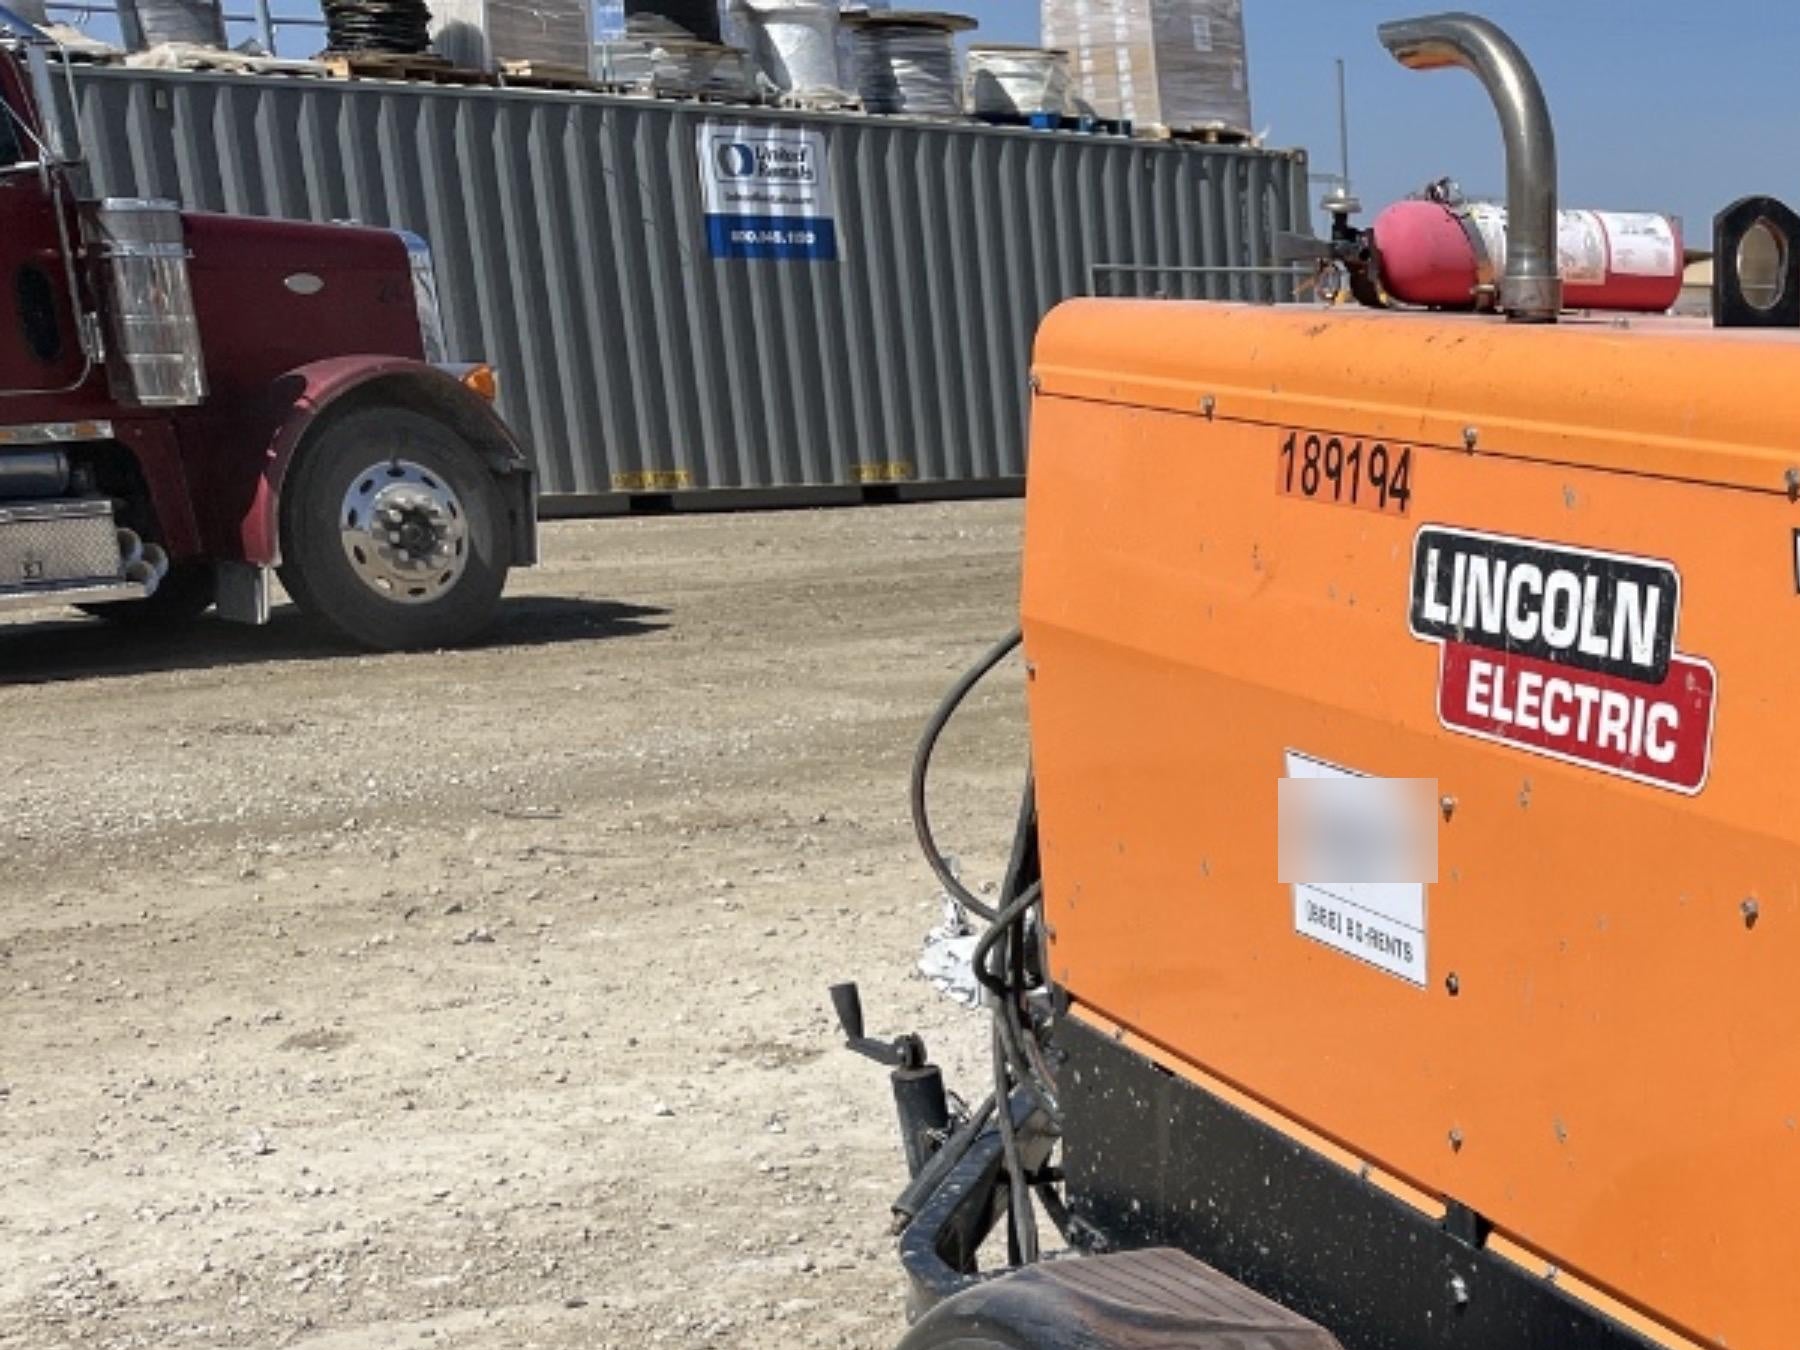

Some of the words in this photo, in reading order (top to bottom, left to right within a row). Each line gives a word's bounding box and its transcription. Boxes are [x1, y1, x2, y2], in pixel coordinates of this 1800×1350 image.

[1281, 431, 1411, 513] 189194
[1421, 547, 1662, 668] LINCOLN
[1465, 658, 1680, 765] ELECTRIC
